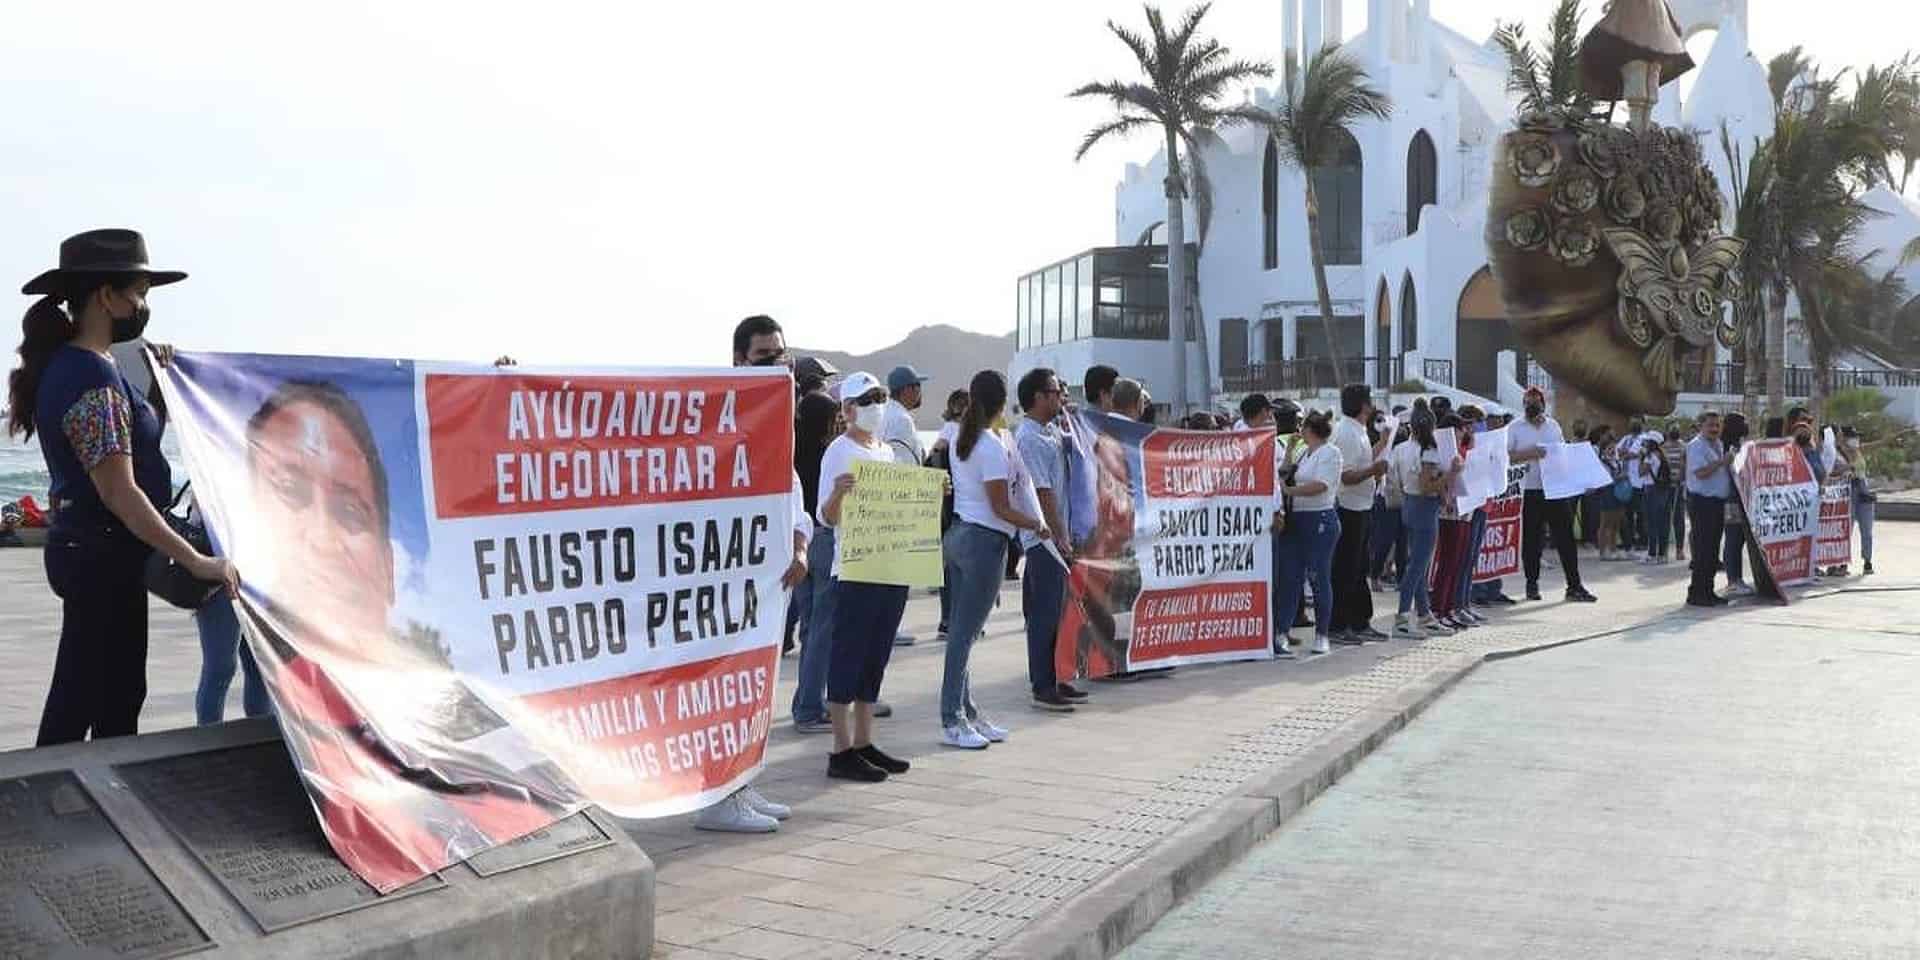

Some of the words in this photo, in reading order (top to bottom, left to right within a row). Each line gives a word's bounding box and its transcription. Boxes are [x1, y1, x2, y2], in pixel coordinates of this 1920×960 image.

[508, 381, 706, 441] AYÚDANOS
[717, 389, 737, 434] A
[496, 446, 716, 504] ENCONTRAR
[731, 443, 752, 488] A
[1247, 464, 1256, 490] A
[1217, 507, 1263, 536] ISAAC
[474, 526, 636, 600] FAUSTO
[658, 514, 769, 577] ISAAC
[1154, 544, 1206, 577] PARDO
[1210, 591, 1252, 613] AMIGOS
[492, 598, 627, 675] PARDO
[646, 579, 758, 648] PERLA
[1149, 620, 1196, 646] ESTAMOS
[1199, 617, 1263, 641] ESPERANDO
[654, 688, 666, 725] Y
[677, 666, 767, 721] AMIGOS
